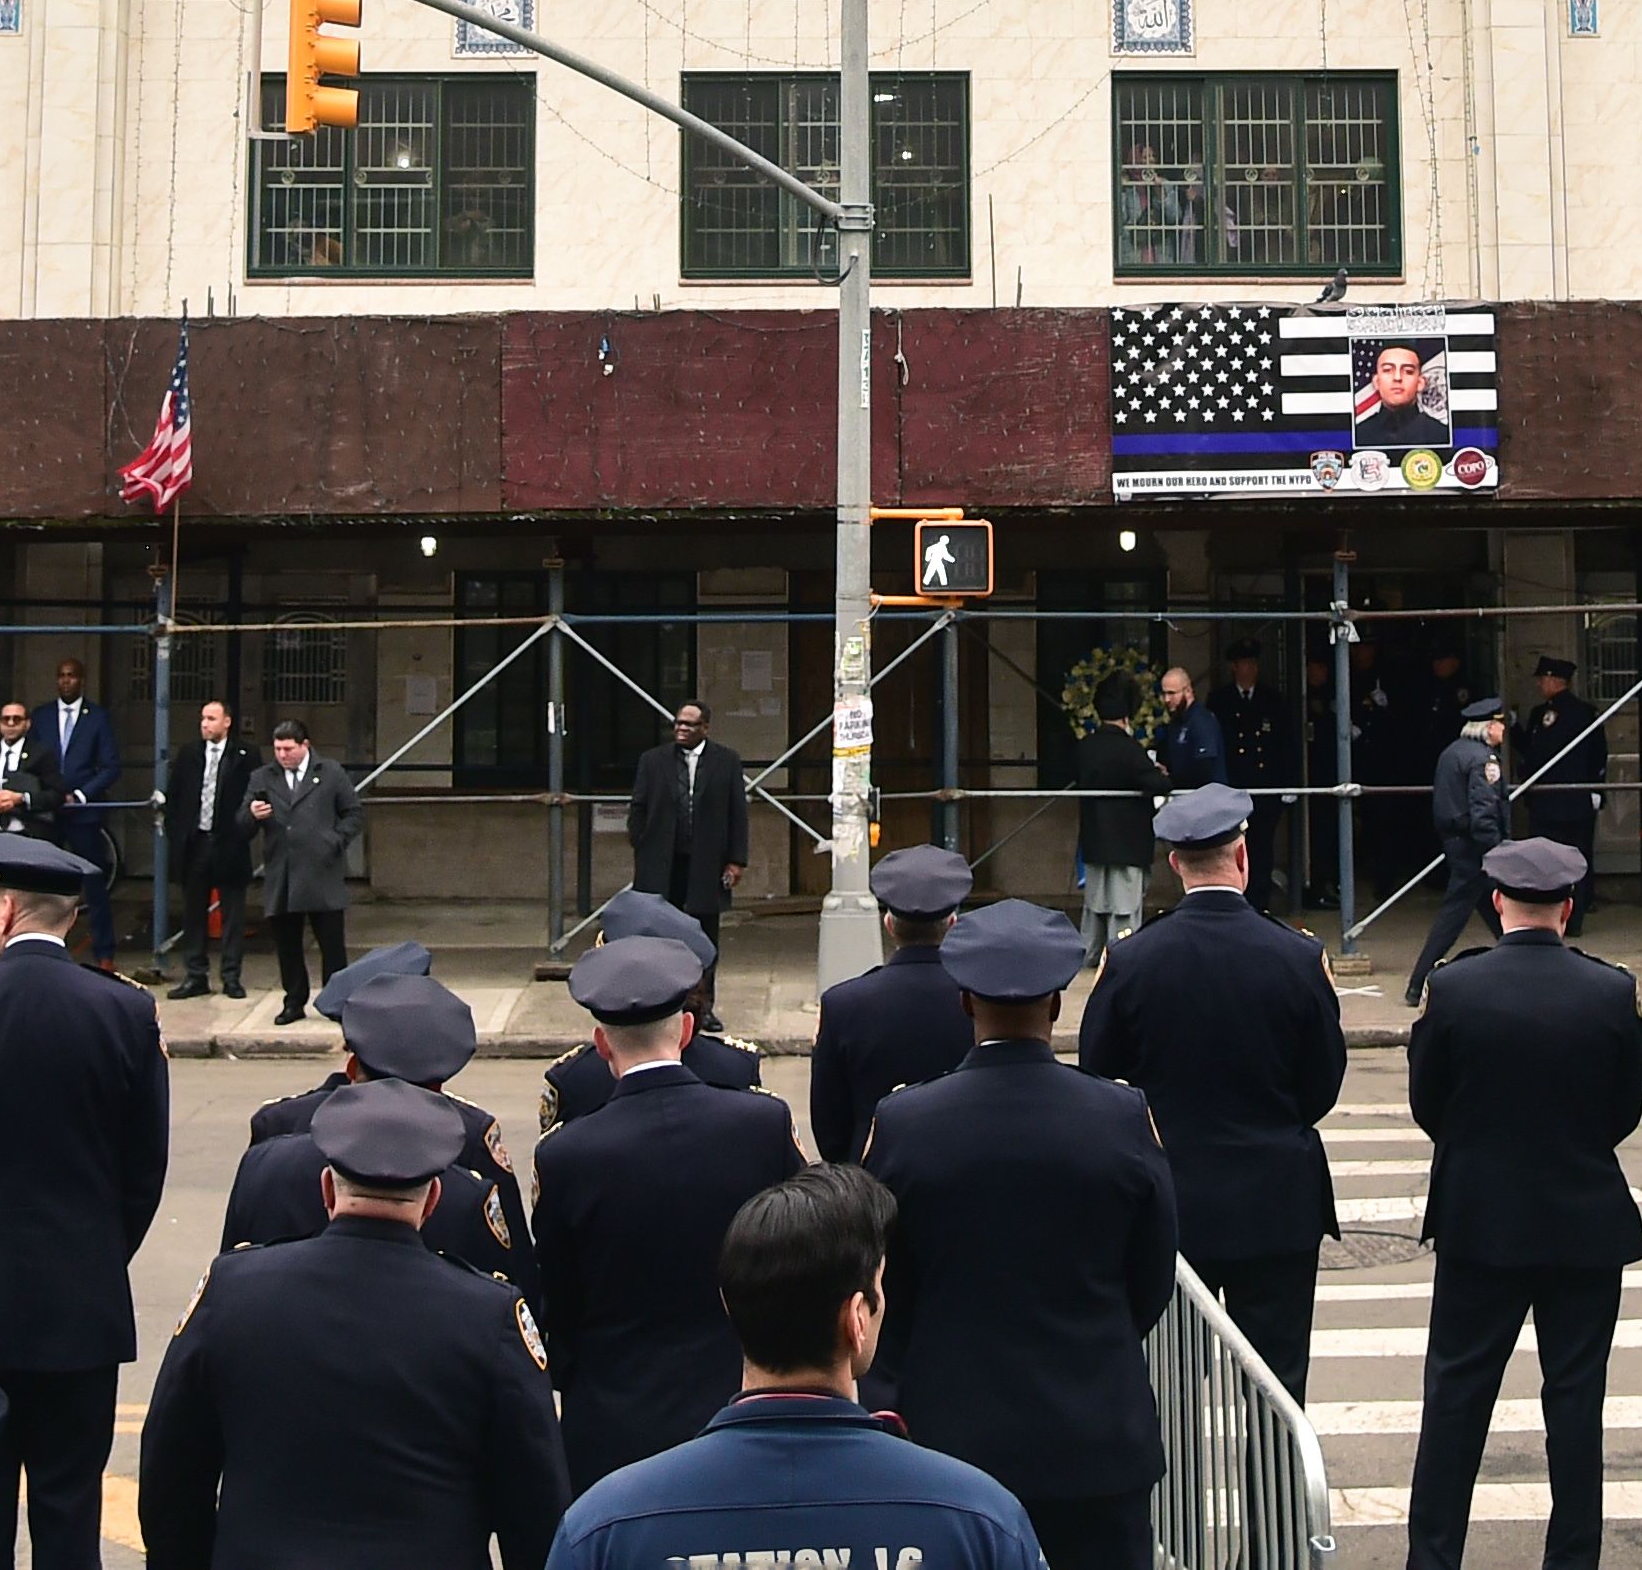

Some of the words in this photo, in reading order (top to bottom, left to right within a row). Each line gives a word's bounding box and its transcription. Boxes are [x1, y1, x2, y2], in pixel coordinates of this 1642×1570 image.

[1457, 462, 1485, 474] COPO
[1117, 478, 1130, 488] WE
[1132, 477, 1164, 488] MOURN
[1165, 477, 1184, 487] OUR
[1185, 476, 1208, 487] HERO
[1209, 476, 1228, 487] AND
[1229, 475, 1269, 486] SUPPORT
[1271, 475, 1287, 485] THE
[1289, 474, 1312, 485] NYPD
